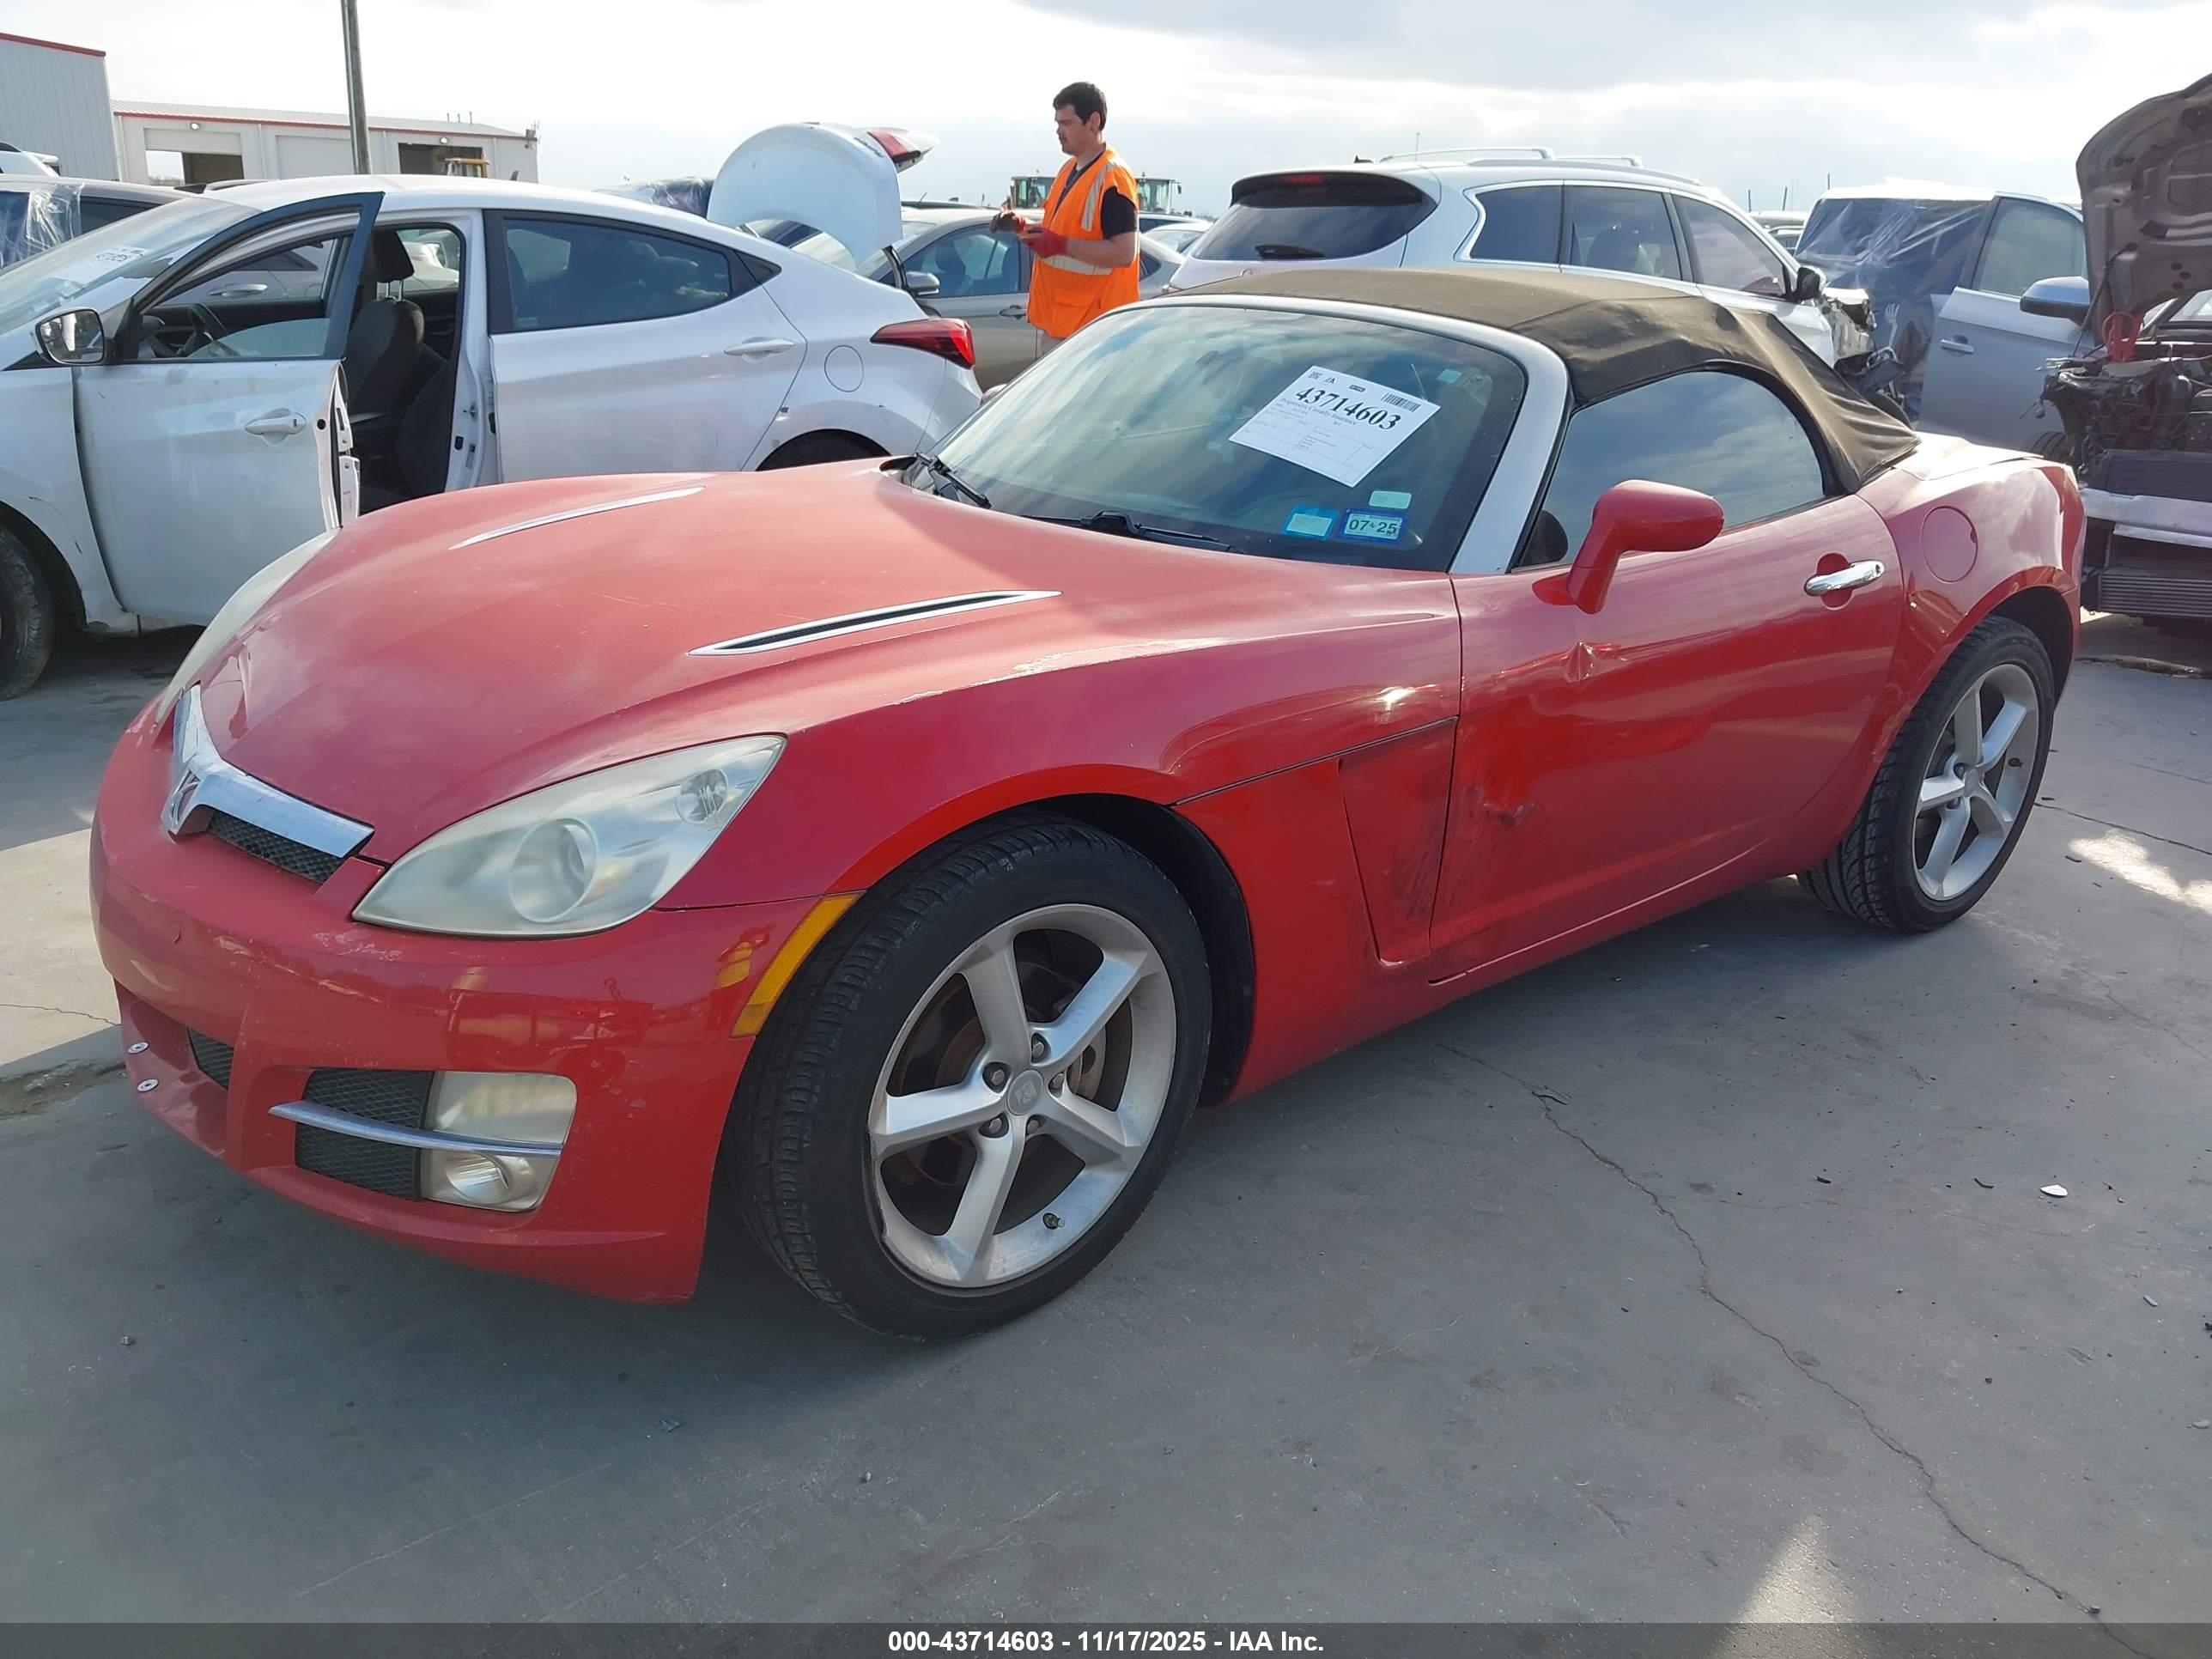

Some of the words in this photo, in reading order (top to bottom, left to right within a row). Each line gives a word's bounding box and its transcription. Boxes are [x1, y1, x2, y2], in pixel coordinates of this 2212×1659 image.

[1295, 386, 1401, 430] 43714603
[1349, 520, 1370, 531] 07
[1376, 521, 1398, 534] 25
